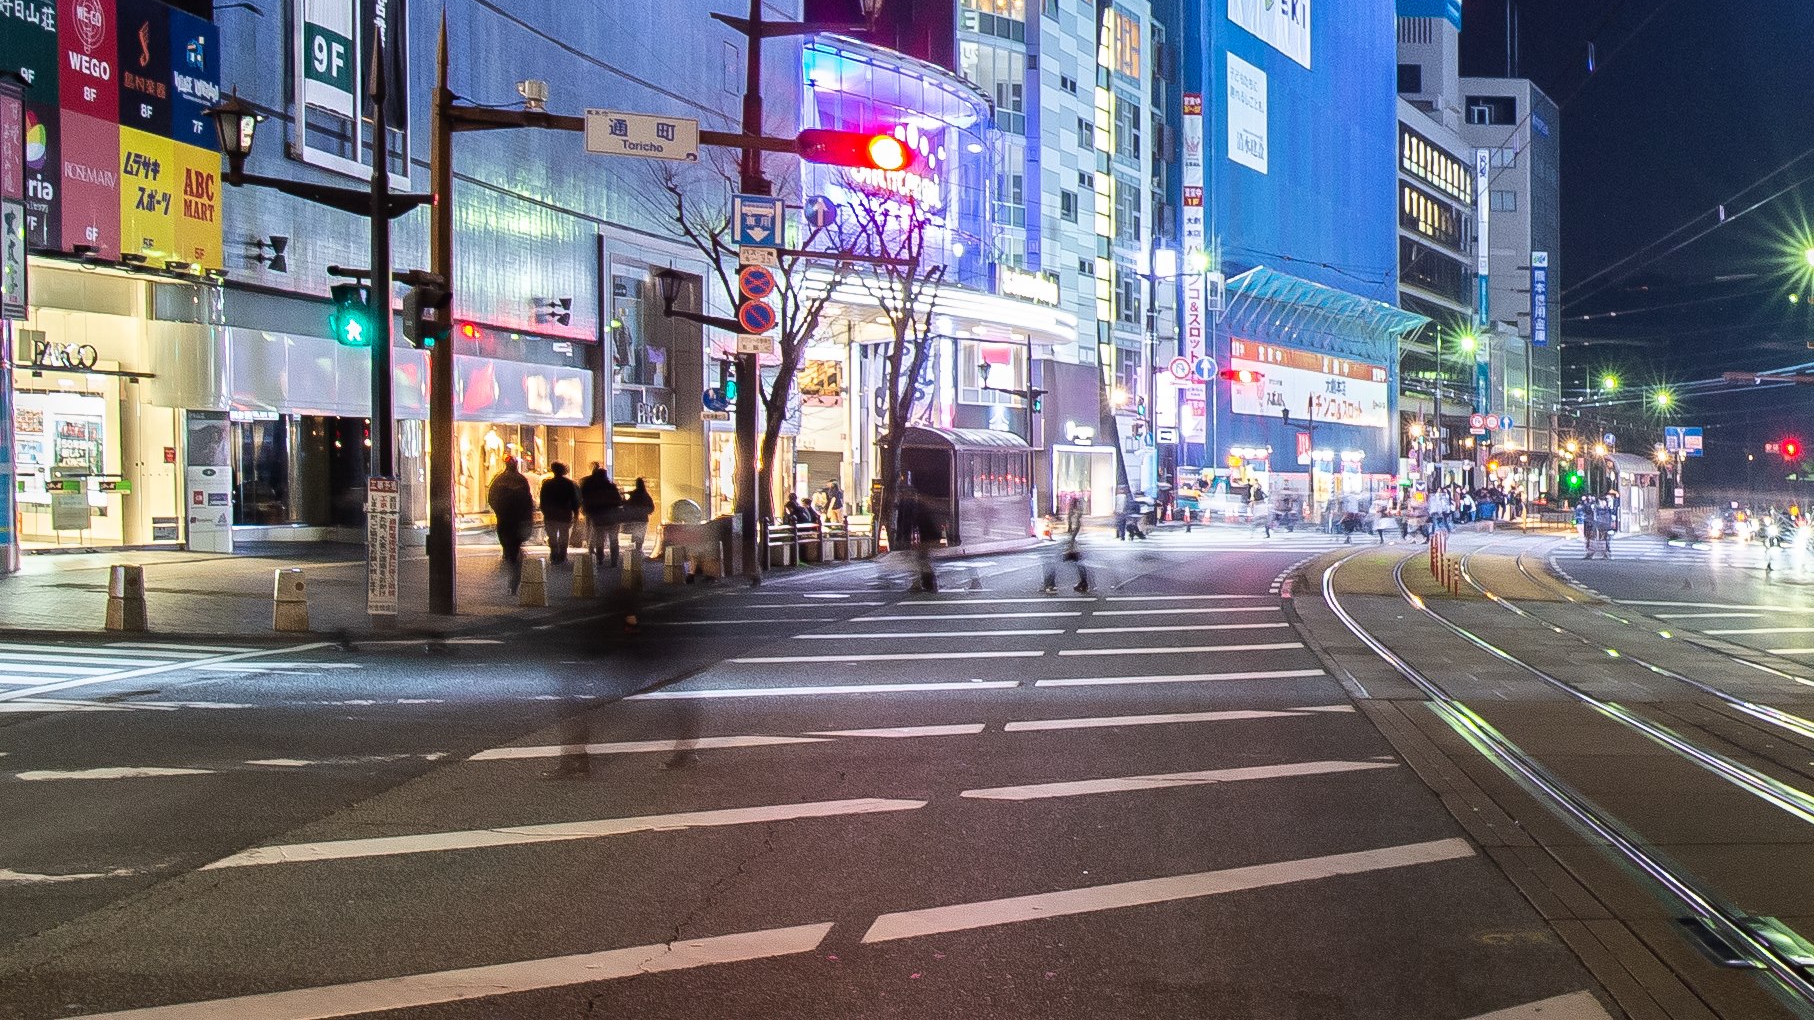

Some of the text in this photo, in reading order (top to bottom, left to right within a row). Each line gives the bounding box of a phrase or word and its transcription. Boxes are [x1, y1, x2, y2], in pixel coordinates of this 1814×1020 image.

[69, 51, 110, 80] WEGO
[314, 35, 344, 78] 9F
[84, 86, 97, 101] 8F
[140, 103, 153, 119] 8F
[192, 119, 203, 134] 7F
[621, 139, 664, 153] Toricho
[65, 162, 117, 188] ROSEMARY
[124, 151, 161, 181] ムラサキ
[183, 167, 215, 205] ABC
[135, 186, 171, 216] スポーツ
[184, 197, 215, 223] MART
[86, 226, 98, 242] 6F
[195, 247, 205, 260] 5F
[1188, 245, 1201, 364] パンコ&スロット
[34, 340, 98, 370] PARCO
